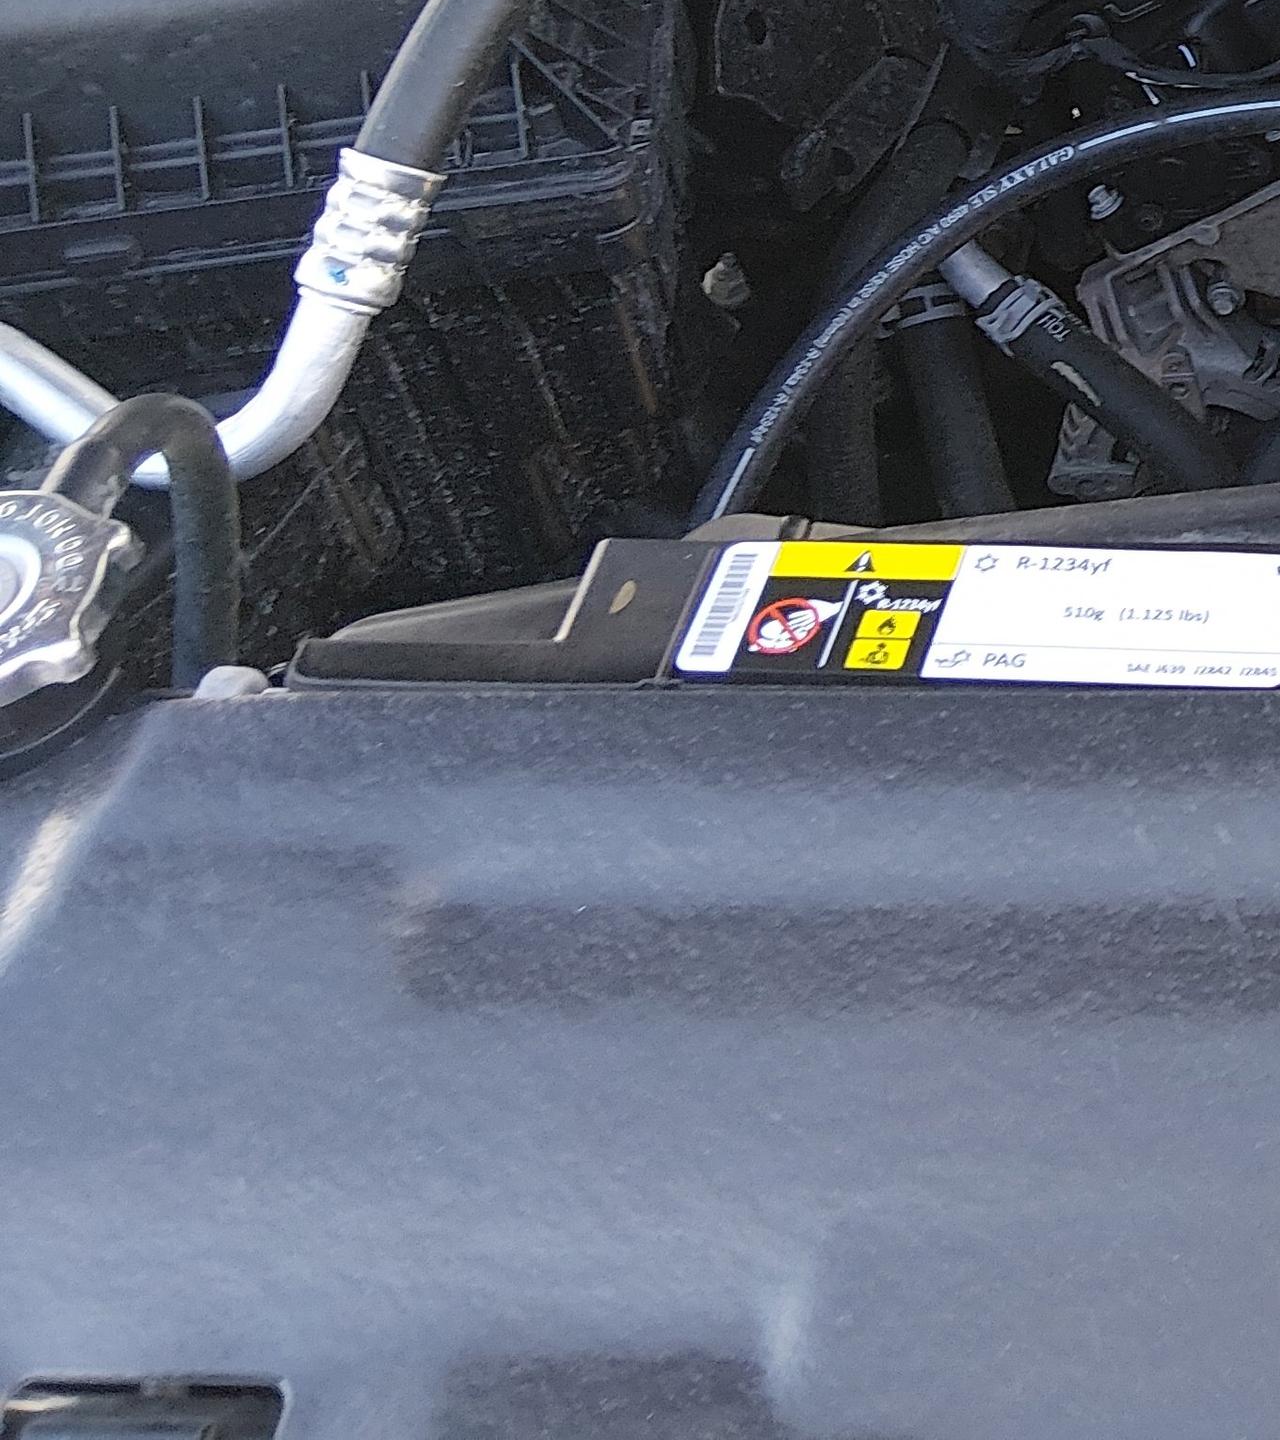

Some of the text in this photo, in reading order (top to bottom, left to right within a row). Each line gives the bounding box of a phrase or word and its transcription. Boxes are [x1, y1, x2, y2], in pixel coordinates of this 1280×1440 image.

[995, 146, 1075, 193] GALAXY
[885, 240, 922, 274] HOSE
[1016, 556, 1113, 576] R-1234yf
[1063, 606, 1106, 622] 510g
[1179, 609, 1211, 624] lbs)
[982, 652, 1028, 668] PAG
